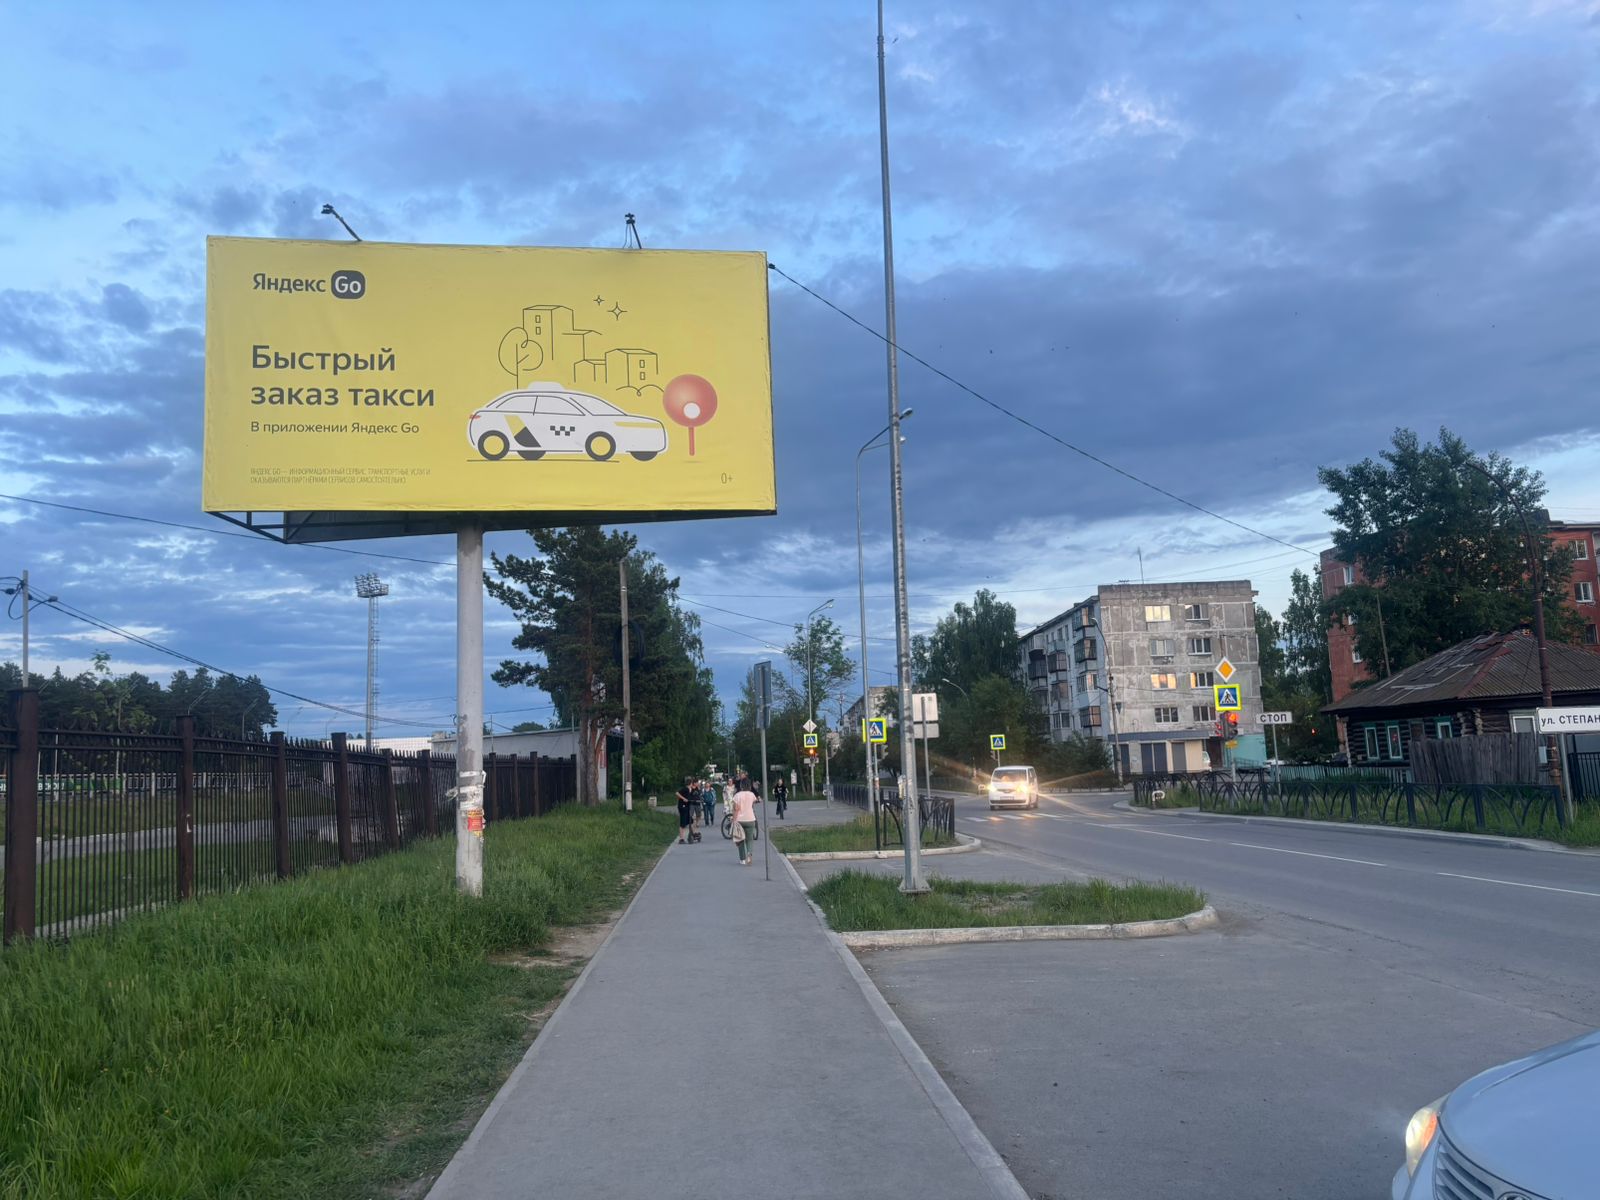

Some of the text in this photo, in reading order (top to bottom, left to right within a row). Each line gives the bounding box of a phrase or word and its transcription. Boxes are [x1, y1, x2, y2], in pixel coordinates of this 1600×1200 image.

[253, 273, 362, 294] Яндекс Go
[252, 345, 395, 375] Быстрый
[251, 386, 435, 406] заказ такси
[250, 421, 420, 434] В приложении Яндекс Go
[1260, 713, 1287, 723] СТОП
[1541, 717, 1556, 728] ул.
